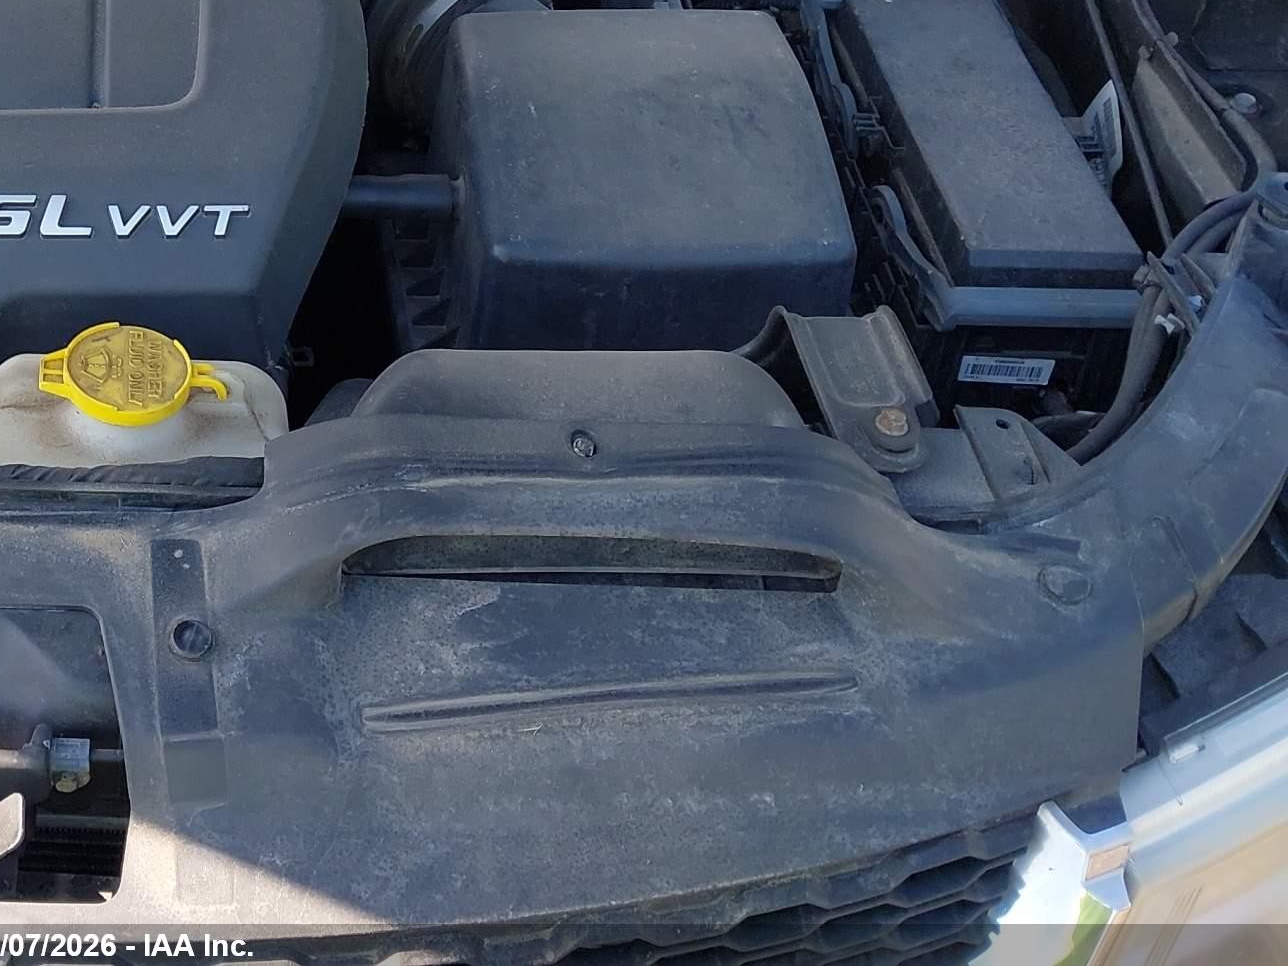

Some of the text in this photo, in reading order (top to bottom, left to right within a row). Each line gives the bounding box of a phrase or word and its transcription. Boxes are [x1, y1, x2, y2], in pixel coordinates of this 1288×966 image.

[108, 205, 250, 237] VVT
[128, 330, 145, 407] FLUID ONLY
[147, 338, 164, 400] WASHER
